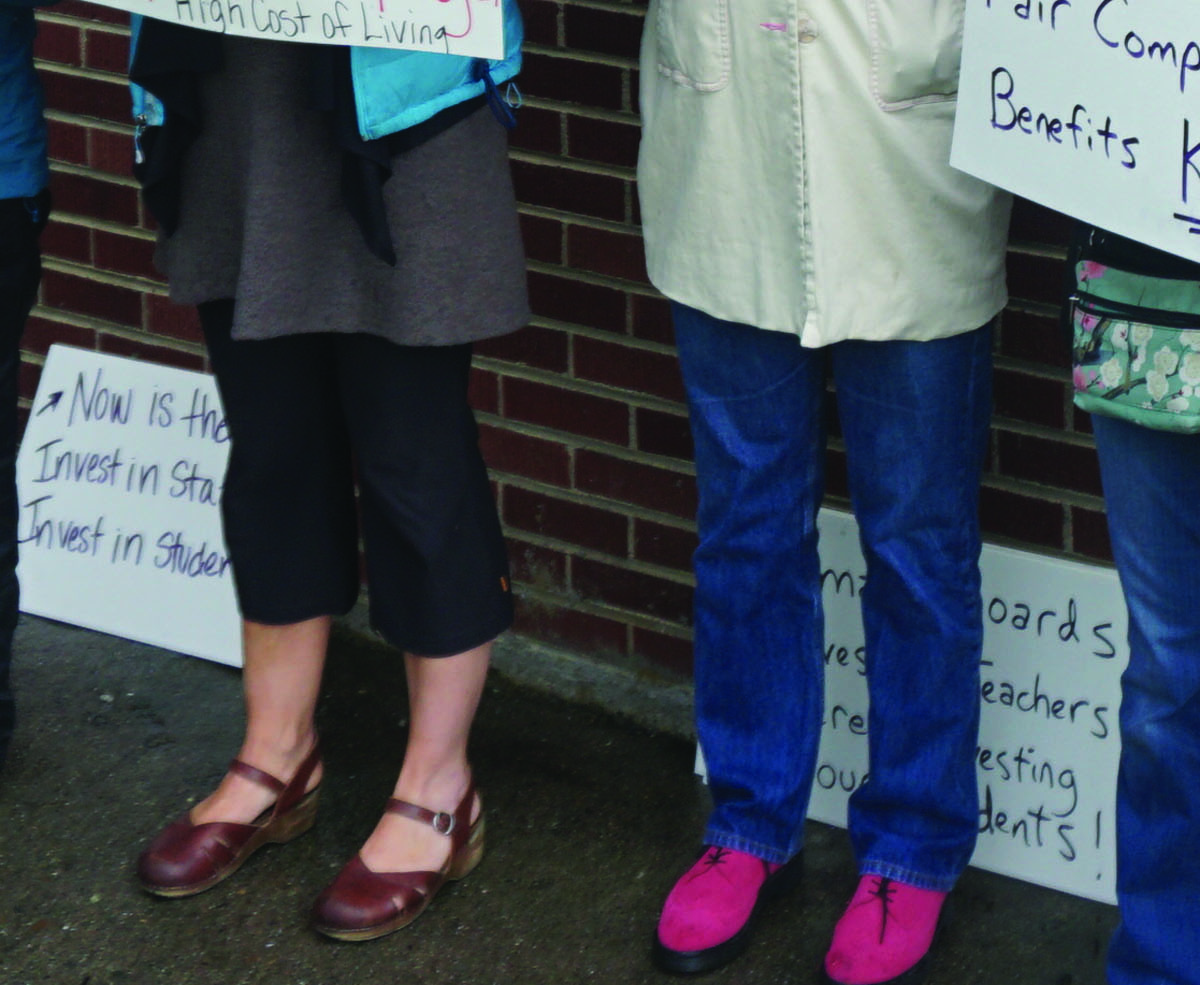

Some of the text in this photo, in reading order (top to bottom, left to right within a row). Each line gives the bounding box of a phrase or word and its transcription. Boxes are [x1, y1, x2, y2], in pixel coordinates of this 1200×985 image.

[322, 1, 352, 39] of
[361, 1, 449, 54] Living
[990, 66, 1140, 169] Benefits
[67, 367, 132, 427] Now
[149, 385, 174, 427] is
[32, 438, 224, 506] Invest in Sta
[17, 495, 104, 556] Invest
[112, 528, 143, 565] in
[988, 597, 1116, 659] oards
